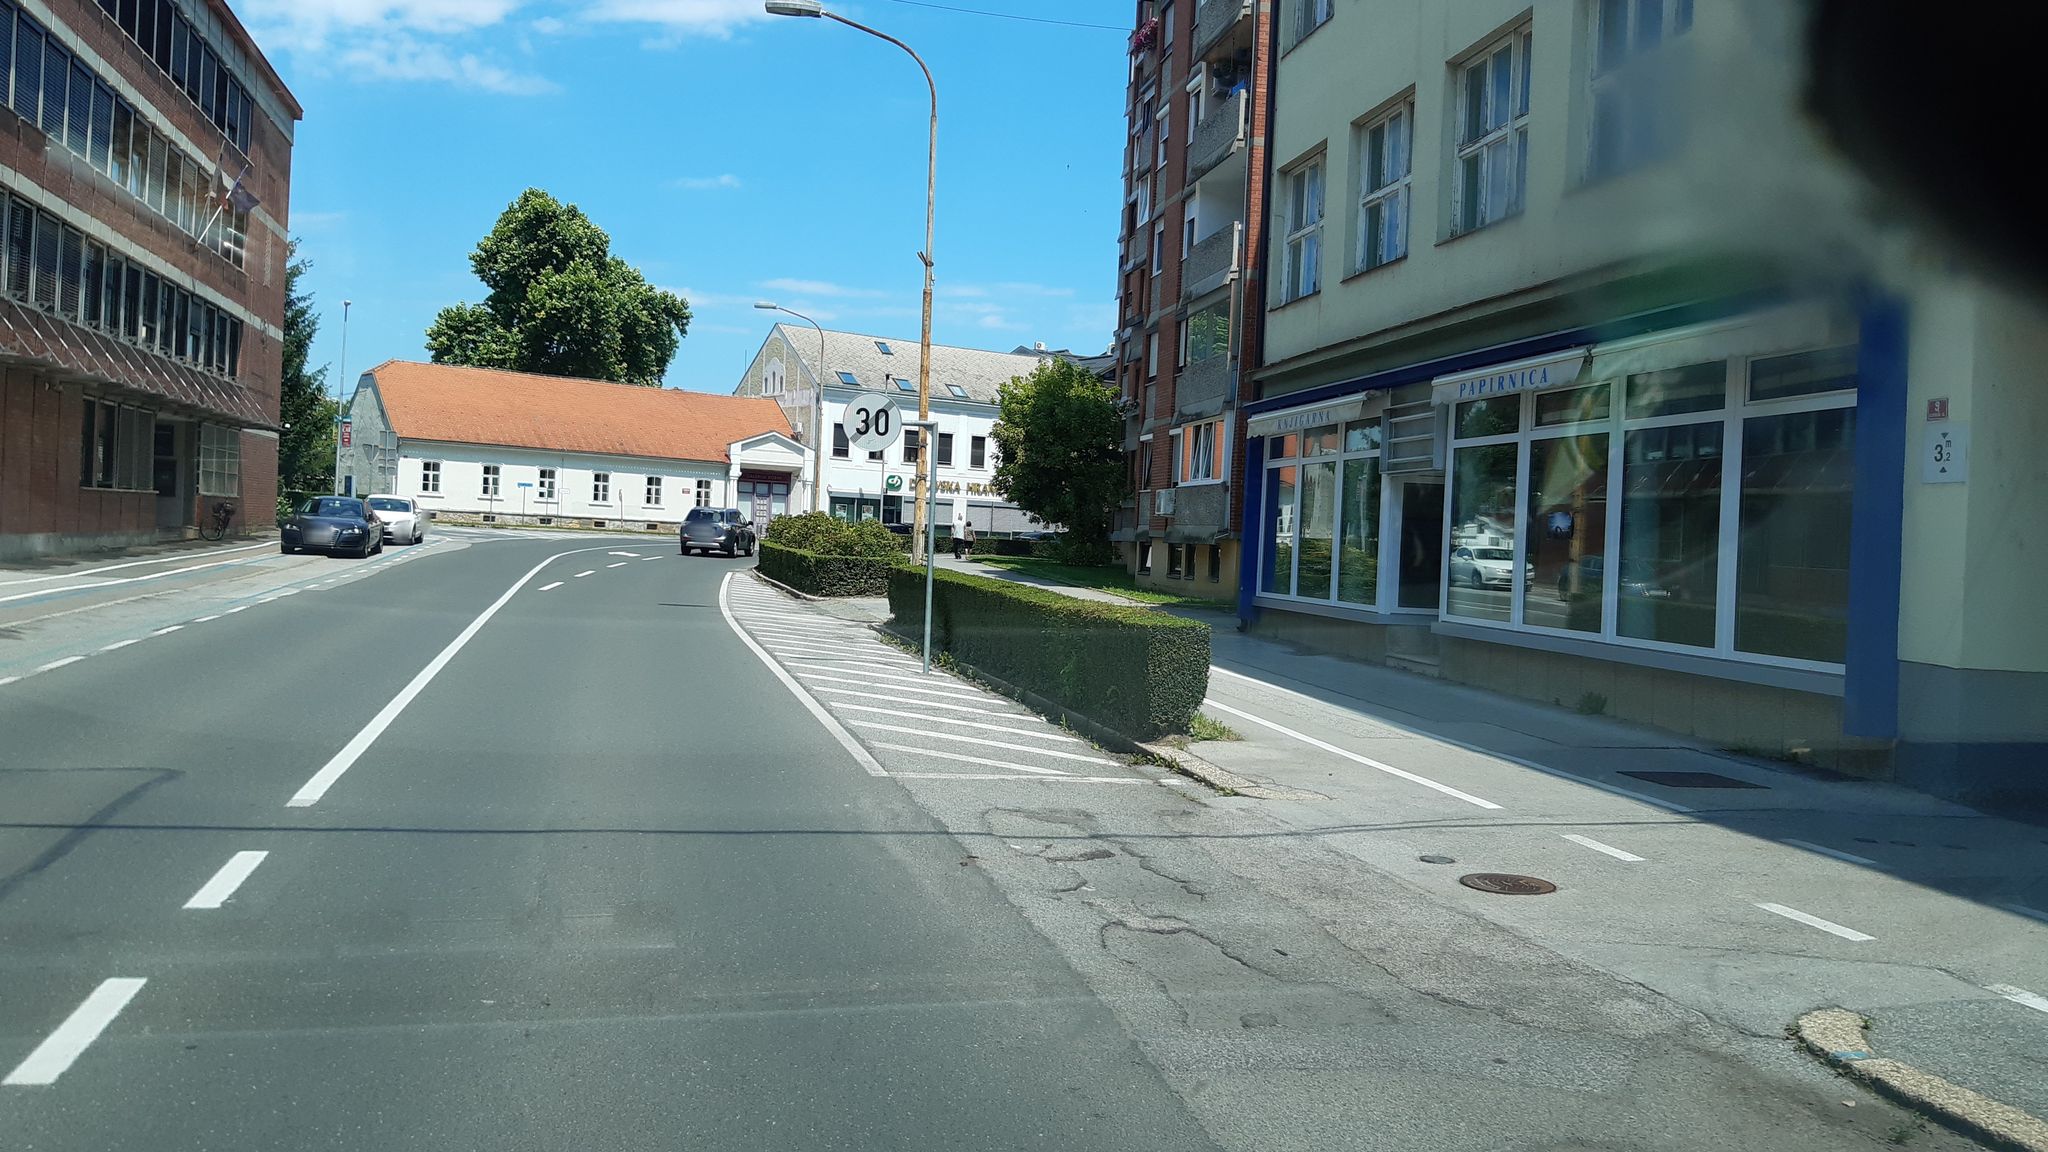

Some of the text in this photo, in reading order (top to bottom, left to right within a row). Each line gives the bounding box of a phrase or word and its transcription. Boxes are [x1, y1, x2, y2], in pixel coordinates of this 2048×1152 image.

[1459, 367, 1548, 398] PAPIRNICA
[855, 407, 890, 437] 30
[1276, 410, 1331, 431] KNJIGARNA
[1945, 440, 1952, 448] m
